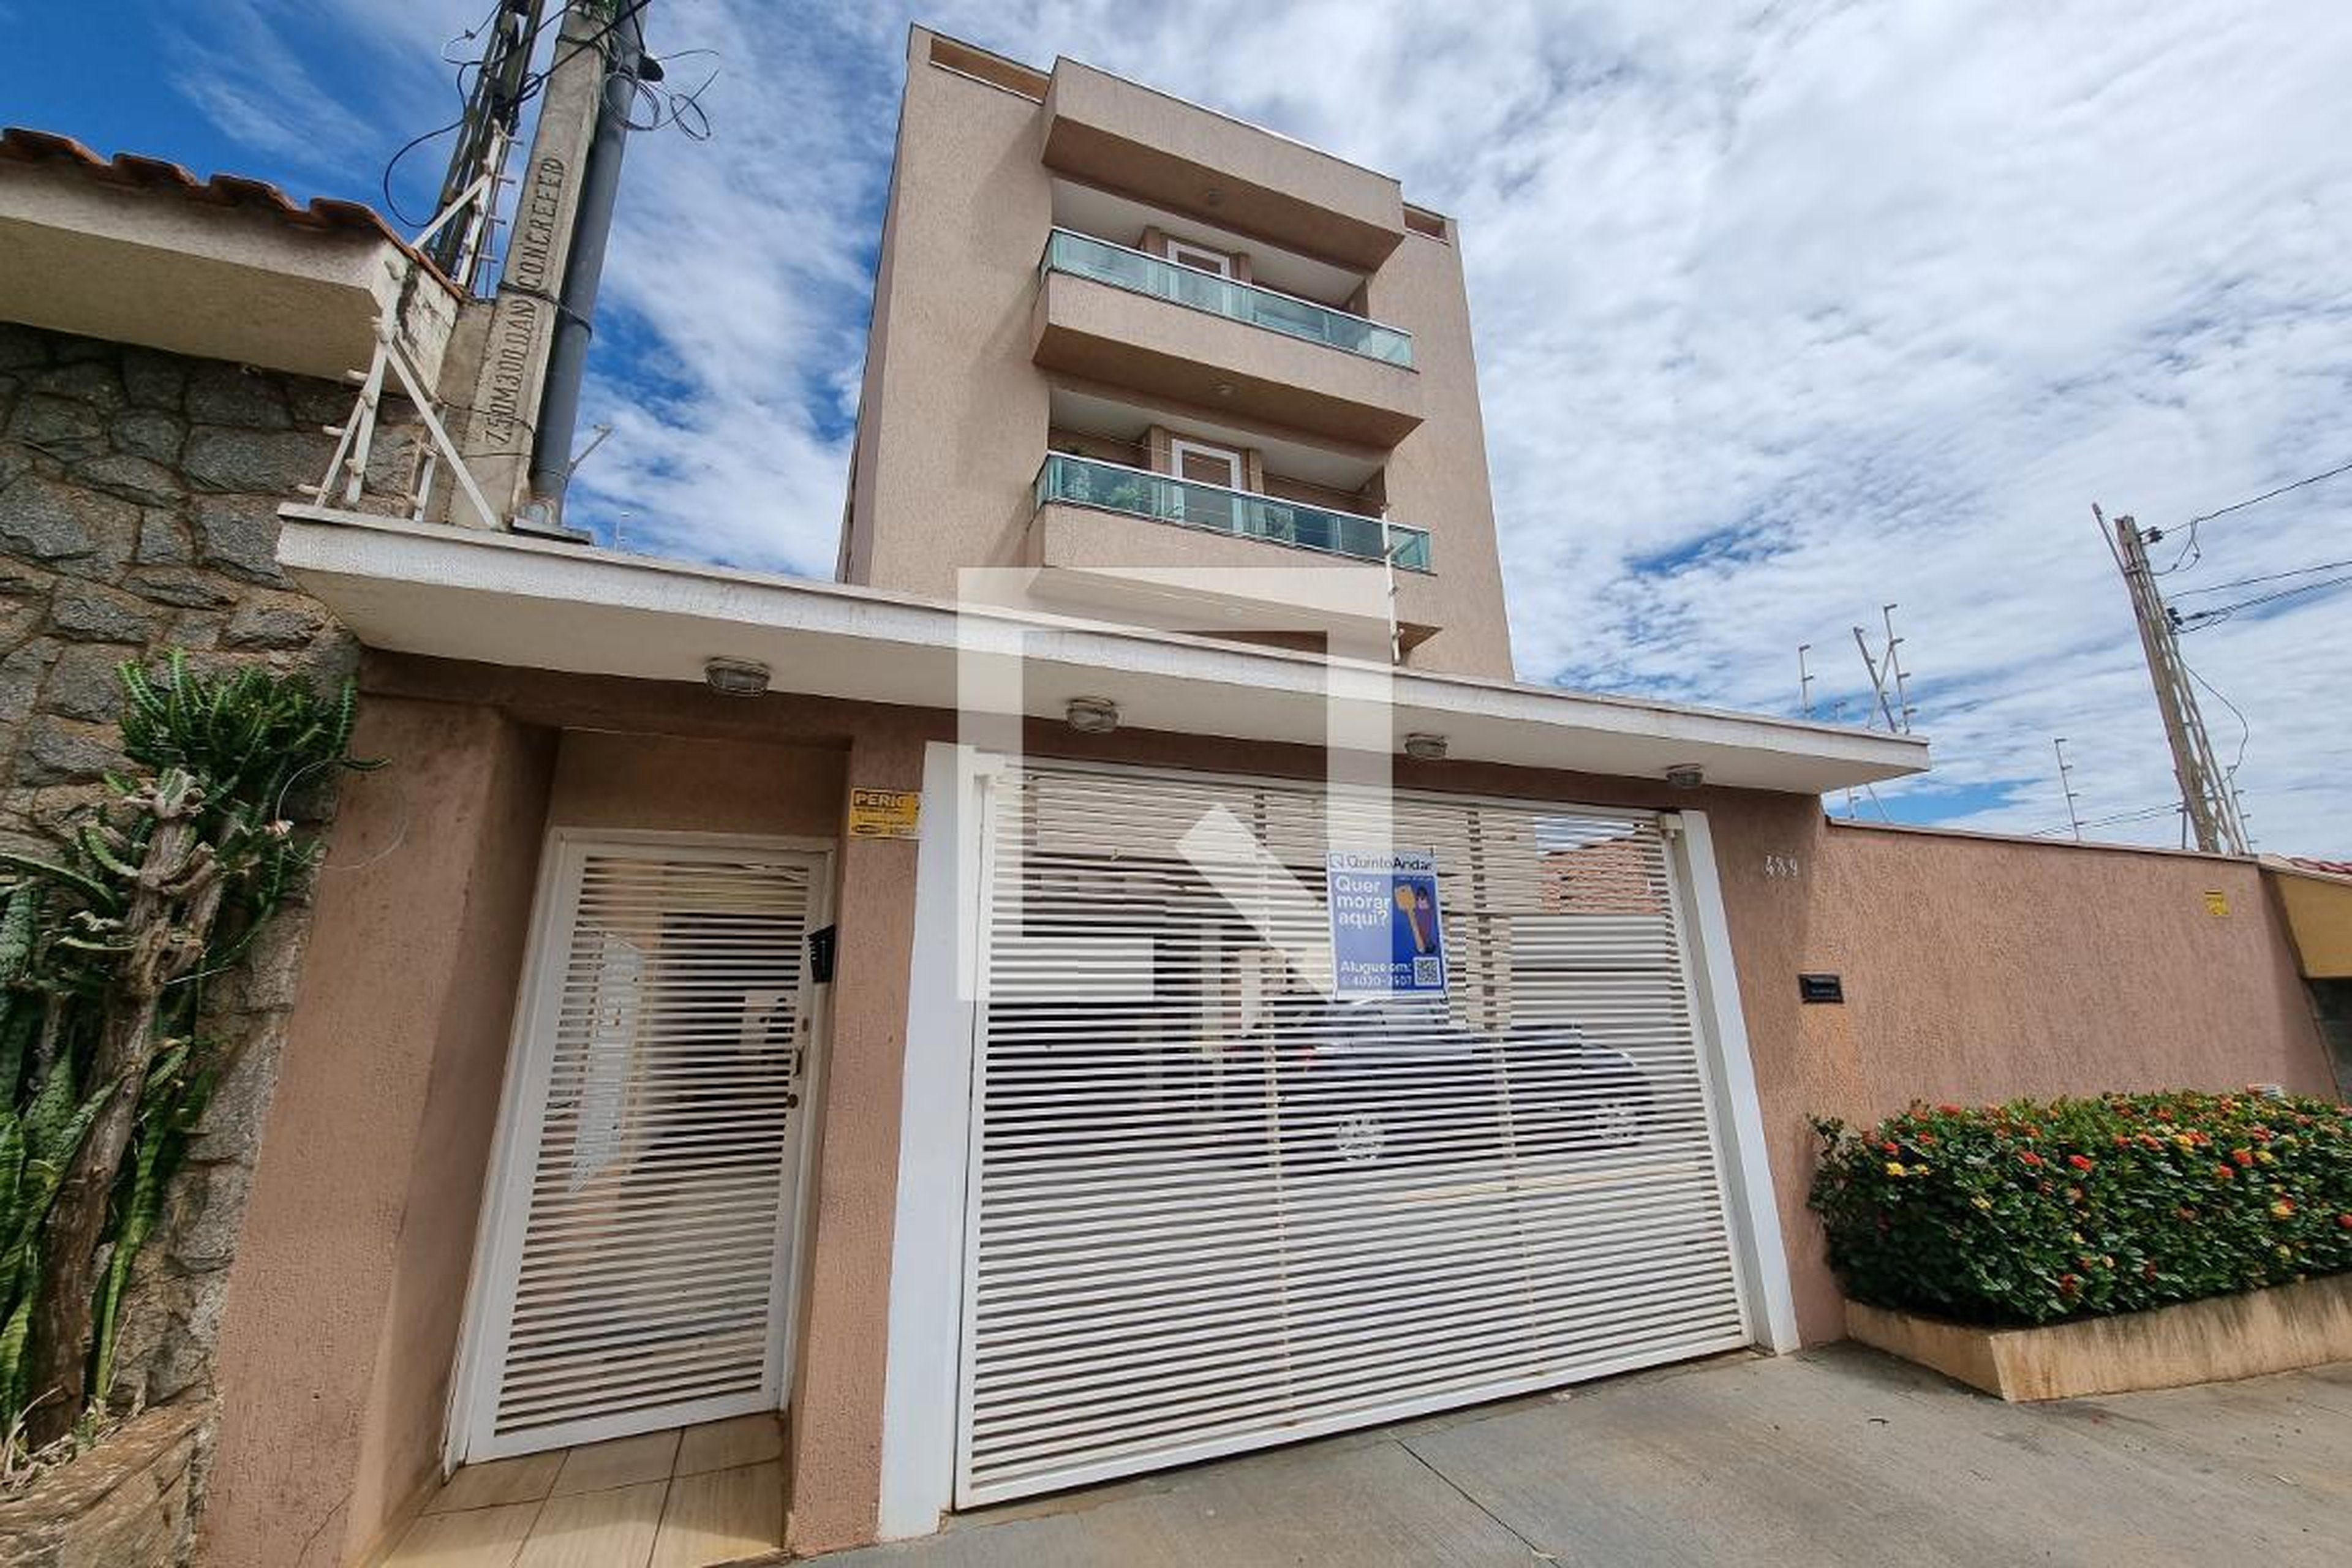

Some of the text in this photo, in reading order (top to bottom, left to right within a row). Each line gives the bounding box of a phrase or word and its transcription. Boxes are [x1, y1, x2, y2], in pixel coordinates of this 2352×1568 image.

[855, 792, 909, 808] PERIG
[1347, 854, 1432, 871] QuintoAndar
[1335, 875, 1381, 893] Quer
[1336, 895, 1392, 910] morar
[1338, 911, 1389, 929] aqui?
[1340, 960, 1387, 974] Alugue
